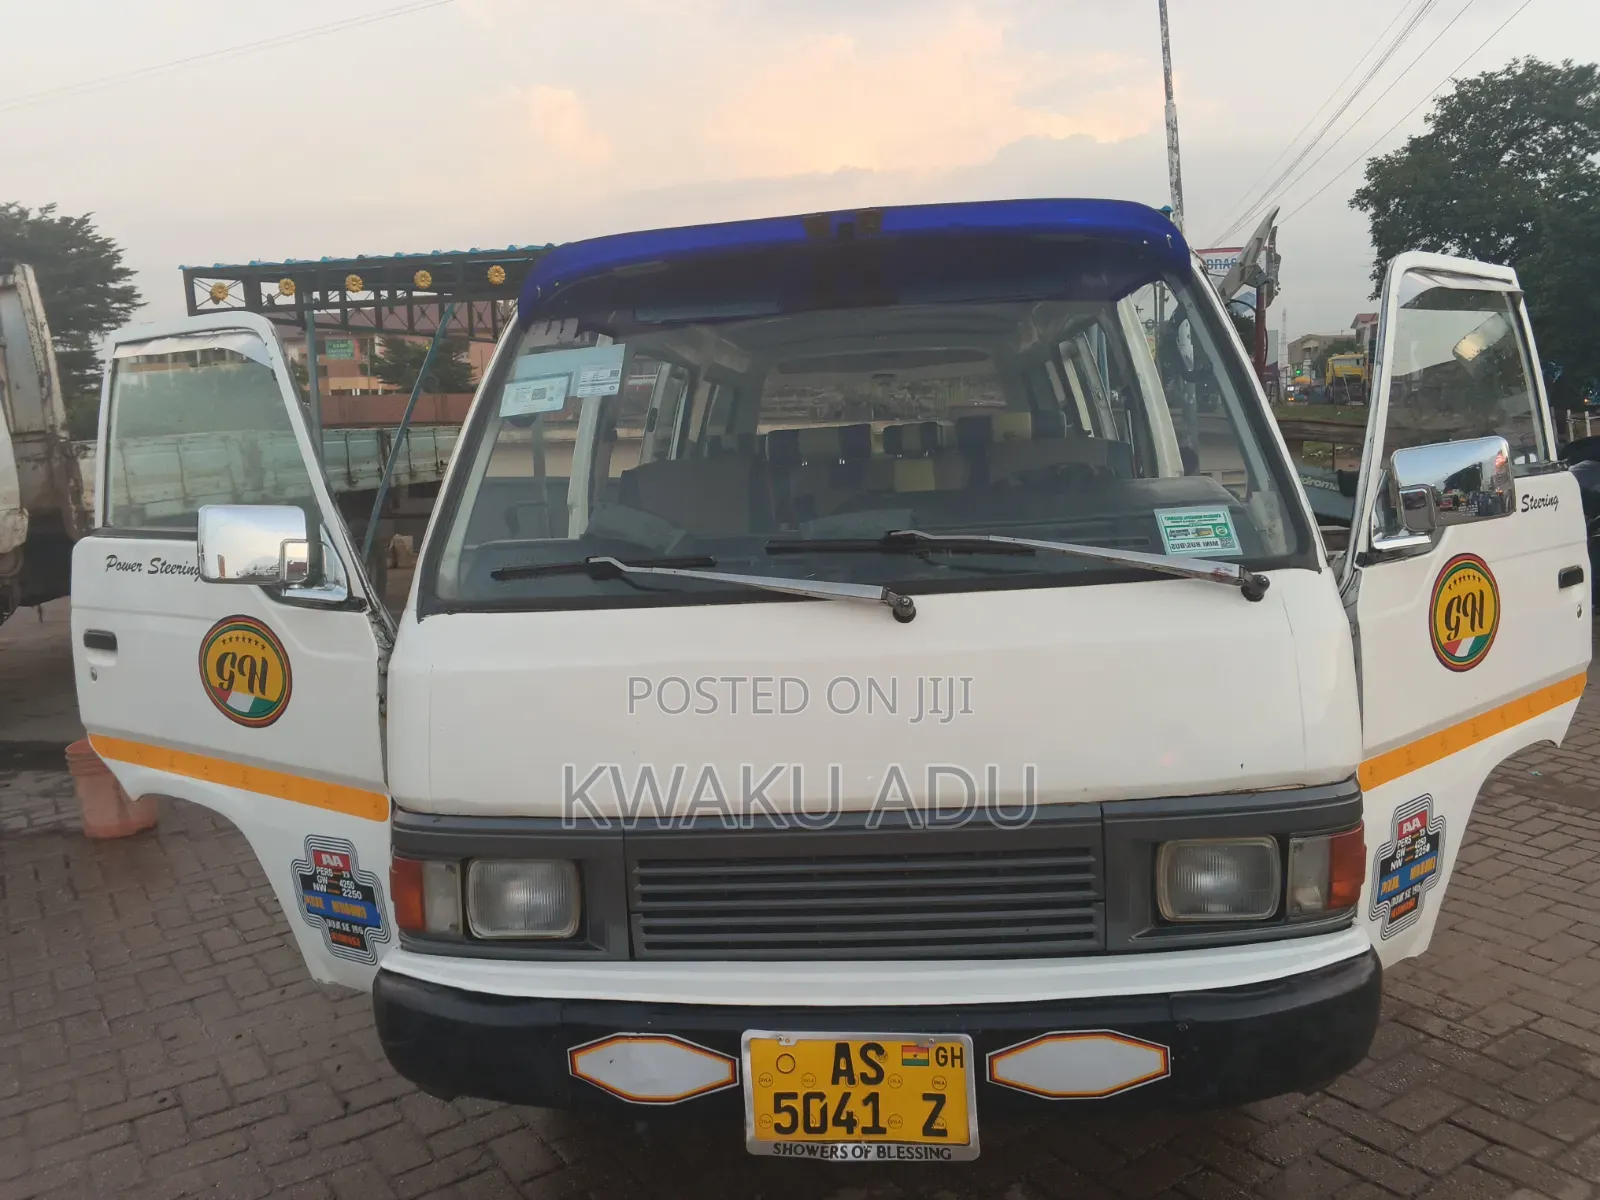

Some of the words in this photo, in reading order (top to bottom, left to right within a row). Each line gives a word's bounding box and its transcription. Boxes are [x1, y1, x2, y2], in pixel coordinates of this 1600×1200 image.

[1521, 494, 1559, 512] Steering
[105, 554, 142, 572] Power
[148, 557, 200, 582] Steering
[1402, 818, 1421, 834] AA
[1398, 835, 1412, 849] PERS
[322, 854, 343, 867] AA
[1396, 848, 1406, 859] GW
[316, 866, 333, 878] PERS
[1390, 858, 1403, 872] NW
[317, 875, 328, 884] GW
[340, 880, 355, 890] 4250
[313, 882, 327, 892] NW
[342, 888, 362, 900] 2250
[831, 1042, 886, 1086] AS
[935, 1046, 964, 1068] GH
[773, 1092, 887, 1135] 5041
[922, 1093, 948, 1137] Z
[773, 1143, 848, 1160] SHOWERS
[851, 1145, 872, 1160] OF
[876, 1145, 952, 1161] BLESSING
